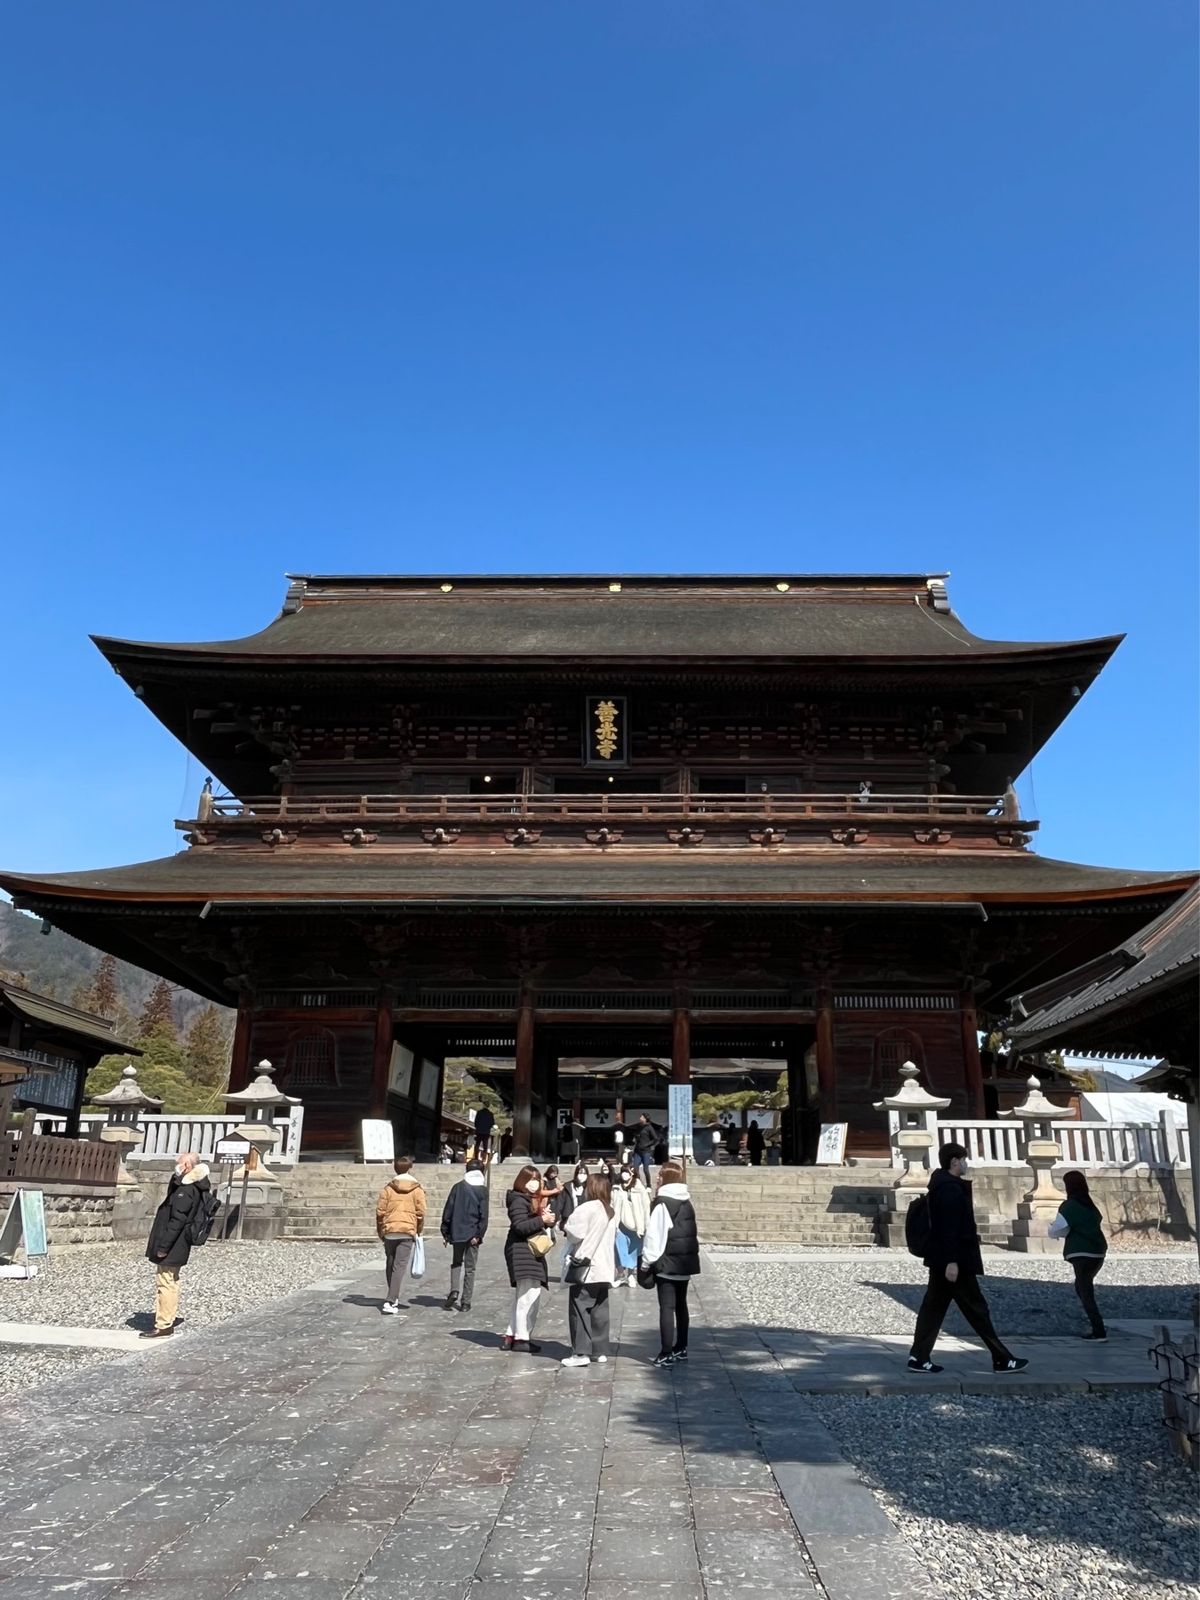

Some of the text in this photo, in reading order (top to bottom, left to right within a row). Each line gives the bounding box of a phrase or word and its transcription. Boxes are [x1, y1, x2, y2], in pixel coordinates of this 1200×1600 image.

[594, 700, 619, 760] 善光寺
[288, 1116, 298, 1154] 善光寺
